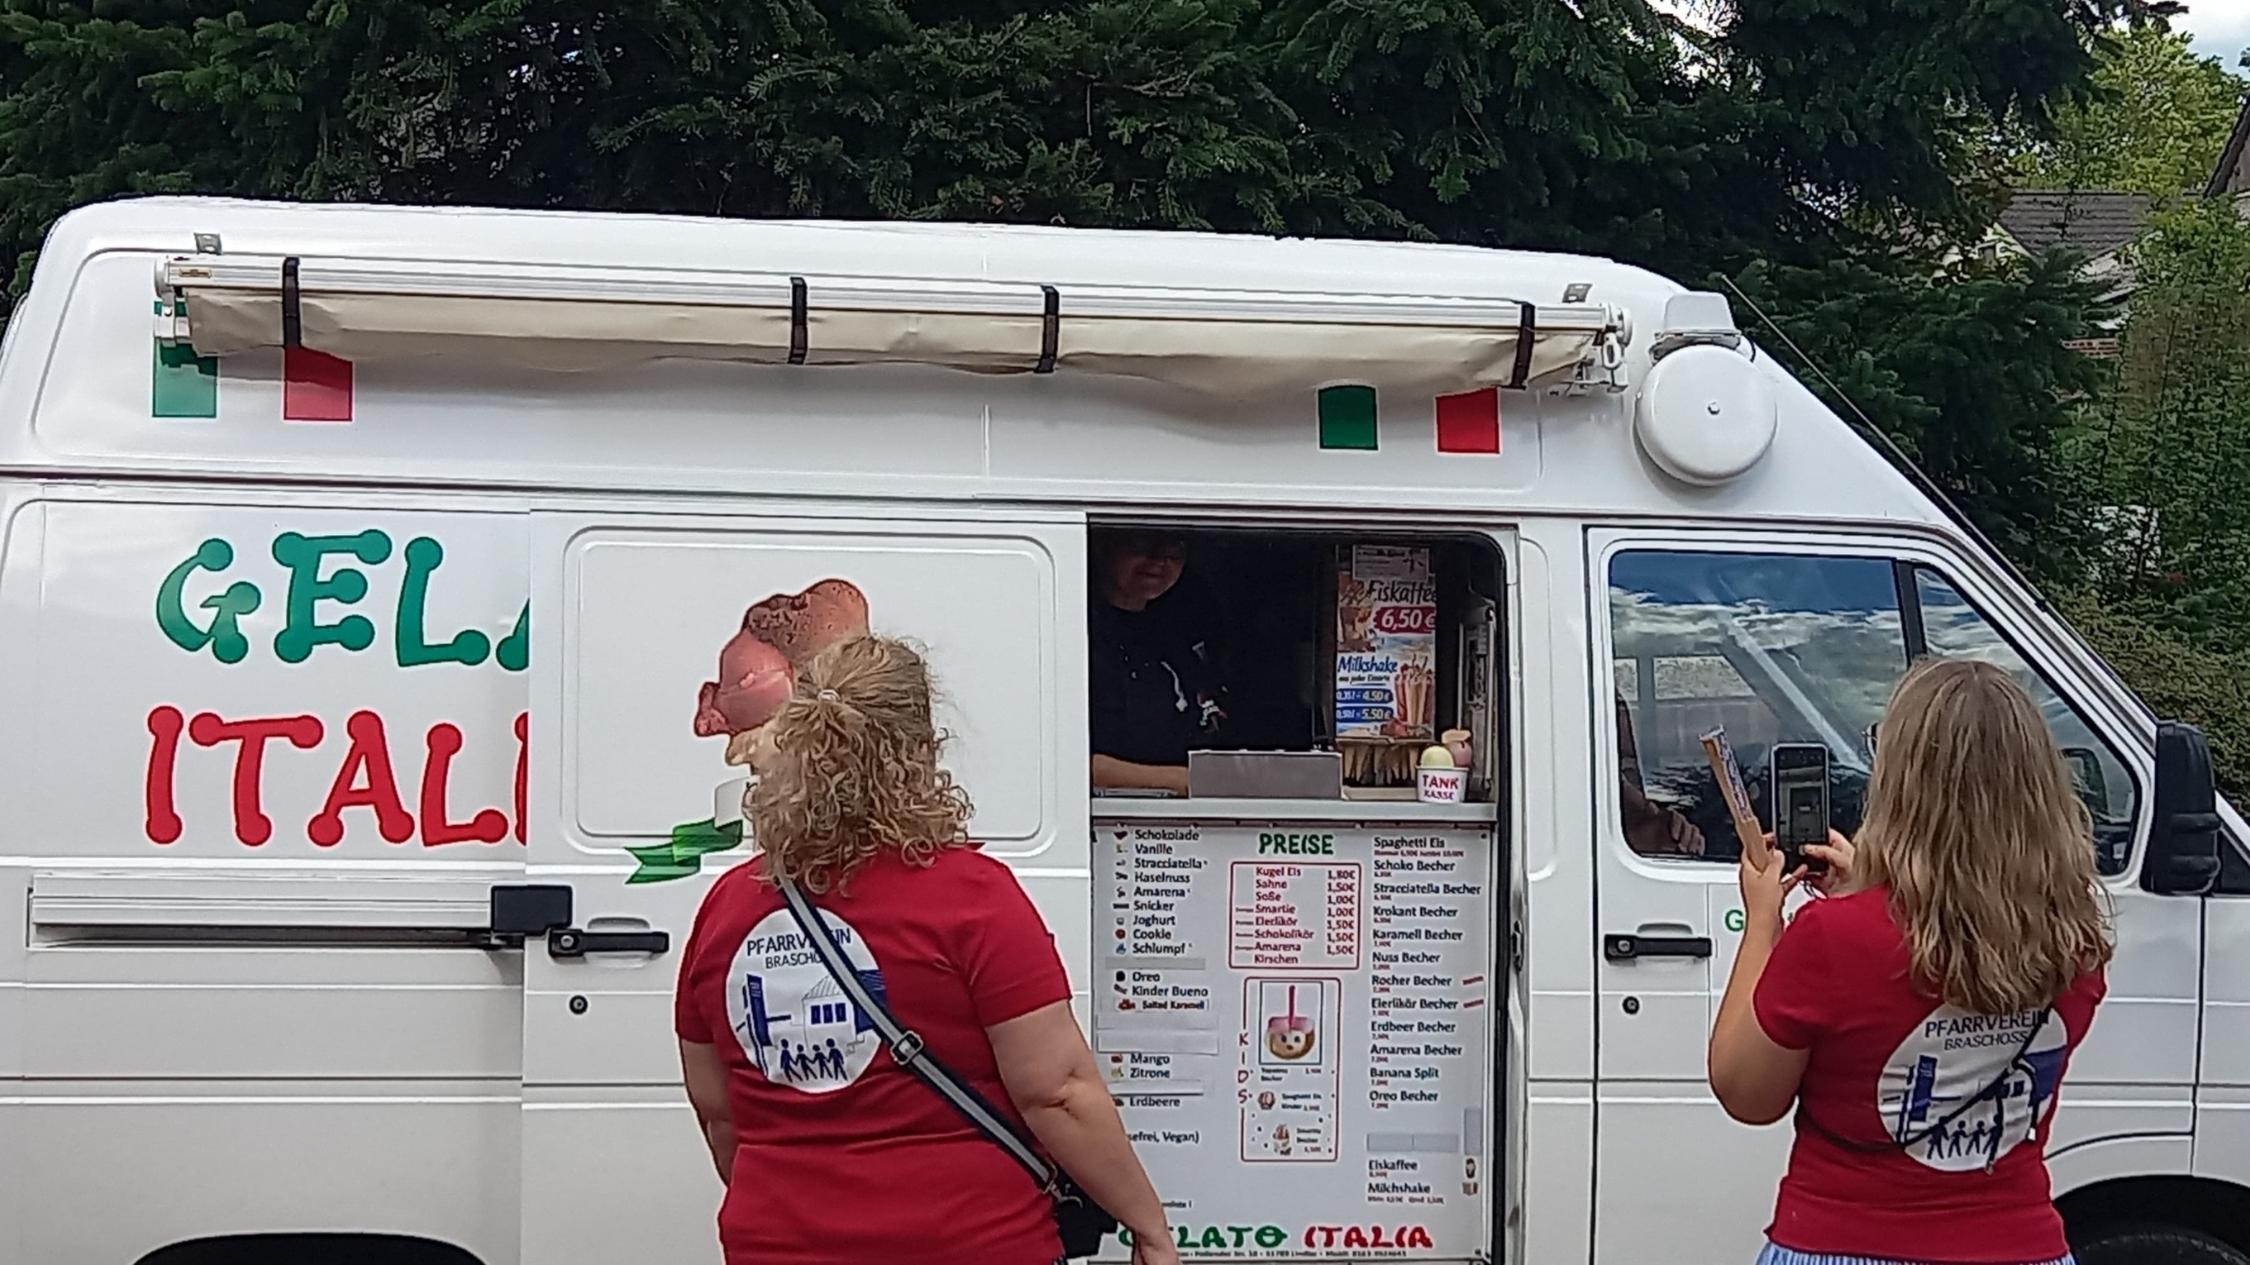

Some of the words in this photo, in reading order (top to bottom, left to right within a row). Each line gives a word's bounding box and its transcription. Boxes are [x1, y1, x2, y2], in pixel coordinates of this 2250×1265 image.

[1381, 608, 1422, 630] 6,50
[1337, 655, 1398, 673] Milkshake
[1422, 774, 1459, 790] TANK
[1134, 829, 1200, 841] Schokolade
[1258, 833, 1335, 855] PREISE
[1373, 836, 1427, 849] Spaghetti
[1429, 837, 1445, 848] Eis
[1134, 843, 1173, 855] Vanille
[1373, 859, 1414, 871] Schoko
[1416, 860, 1455, 871] Becher
[1134, 871, 1190, 883] Haselnuss
[1255, 867, 1286, 879] Kugel
[1287, 867, 1302, 877] Eis
[1255, 879, 1288, 889] Sahne
[1443, 884, 1481, 895] Becher
[1133, 886, 1186, 898] Amarena
[1255, 891, 1282, 902] Soße
[1133, 900, 1174, 911] Snicker
[1255, 904, 1296, 914] Smartie
[1373, 905, 1417, 917] Krokant
[1419, 906, 1458, 917] Becher
[1132, 913, 1176, 927] Joghurt
[1132, 928, 1172, 939] Cookie
[1372, 929, 1422, 940] Karamell
[1424, 929, 1463, 940] Becher
[1132, 942, 1186, 956] Schlumpf
[1254, 941, 1302, 951] Amarena
[1254, 954, 1299, 964] Kirschen
[1372, 951, 1399, 962] Nuss
[1402, 952, 1441, 963] Becher
[1132, 971, 1160, 982] Oreo
[1371, 974, 1410, 986] Rocher
[1413, 975, 1452, 986] Becher
[1132, 986, 1169, 997] Kinder
[1172, 986, 1209, 997] Bueno
[1420, 998, 1458, 1010] Becher
[1371, 1020, 1415, 1031] Erdbeer
[1417, 1021, 1456, 1032] Becher
[1370, 1043, 1421, 1055] Amarena
[1424, 1044, 1463, 1055] Becher
[1129, 1053, 1170, 1066] Mango
[1129, 1068, 1170, 1079] Zitrone
[1370, 1067, 1411, 1078] Banana
[1414, 1066, 1440, 1080] Split
[1129, 1096, 1181, 1107] Erdbeere
[1369, 1090, 1398, 1101] Oreo
[1400, 1090, 1439, 1101] Becher
[1368, 1159, 1418, 1171] Eiskaffee
[1368, 1182, 1431, 1193] Milchshake
[1304, 1226, 1433, 1249] ITALIA
